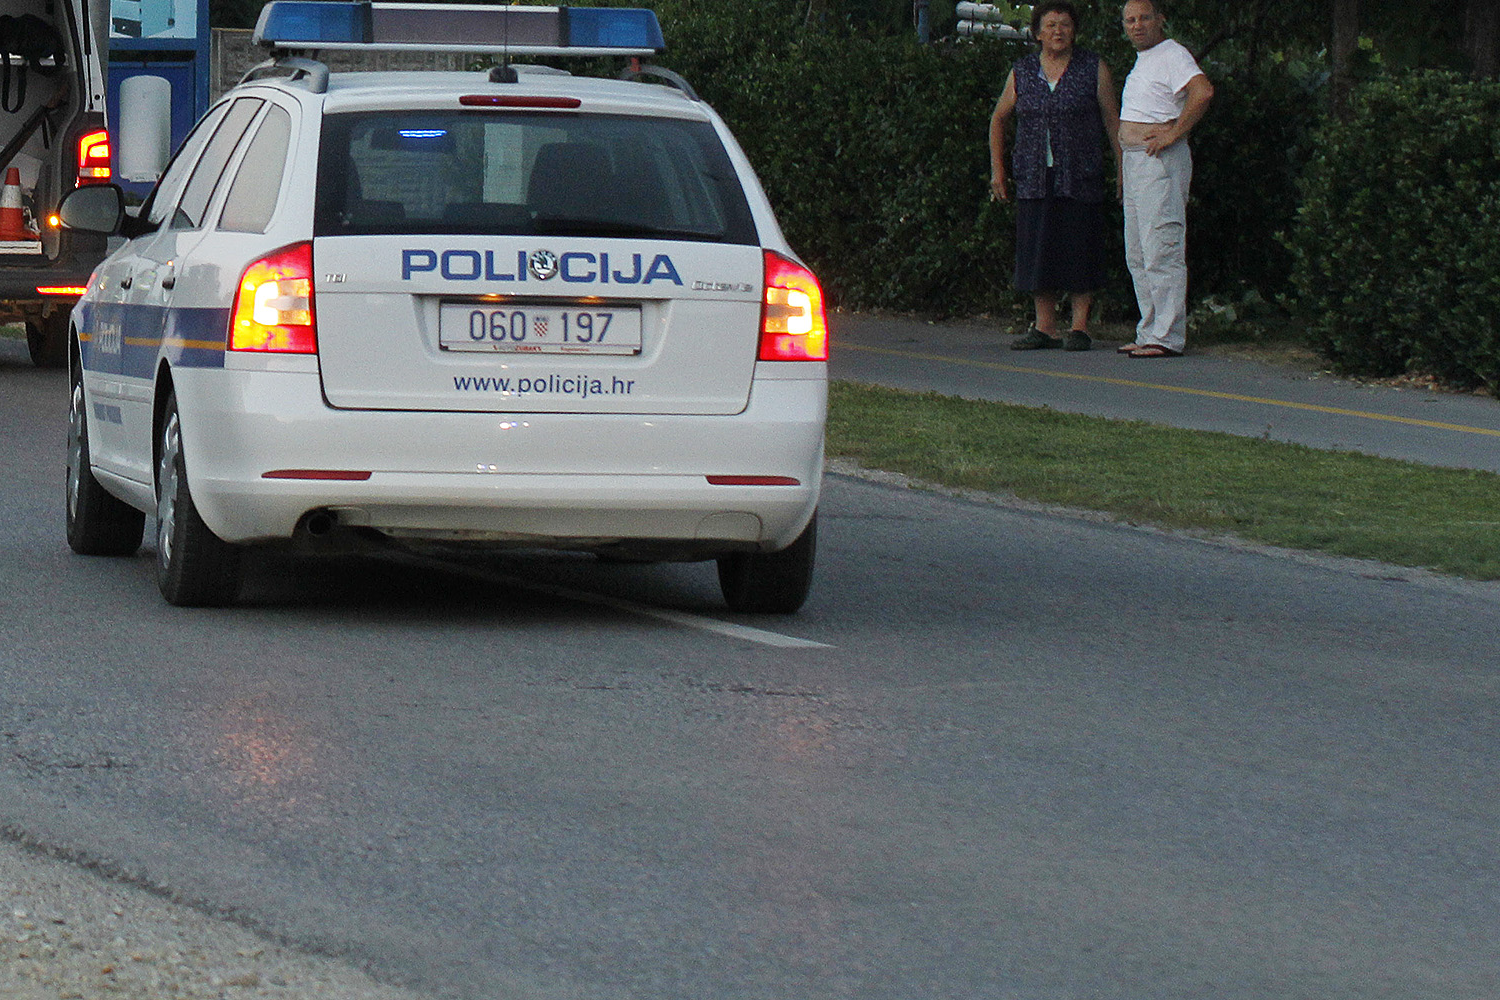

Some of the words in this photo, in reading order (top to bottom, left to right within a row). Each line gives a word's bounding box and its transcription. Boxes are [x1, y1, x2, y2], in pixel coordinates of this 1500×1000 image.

[402, 250, 684, 286] POLICIJA
[469, 310, 526, 341] 060
[561, 312, 613, 343] 197
[453, 375, 635, 398] www.policija.hr
